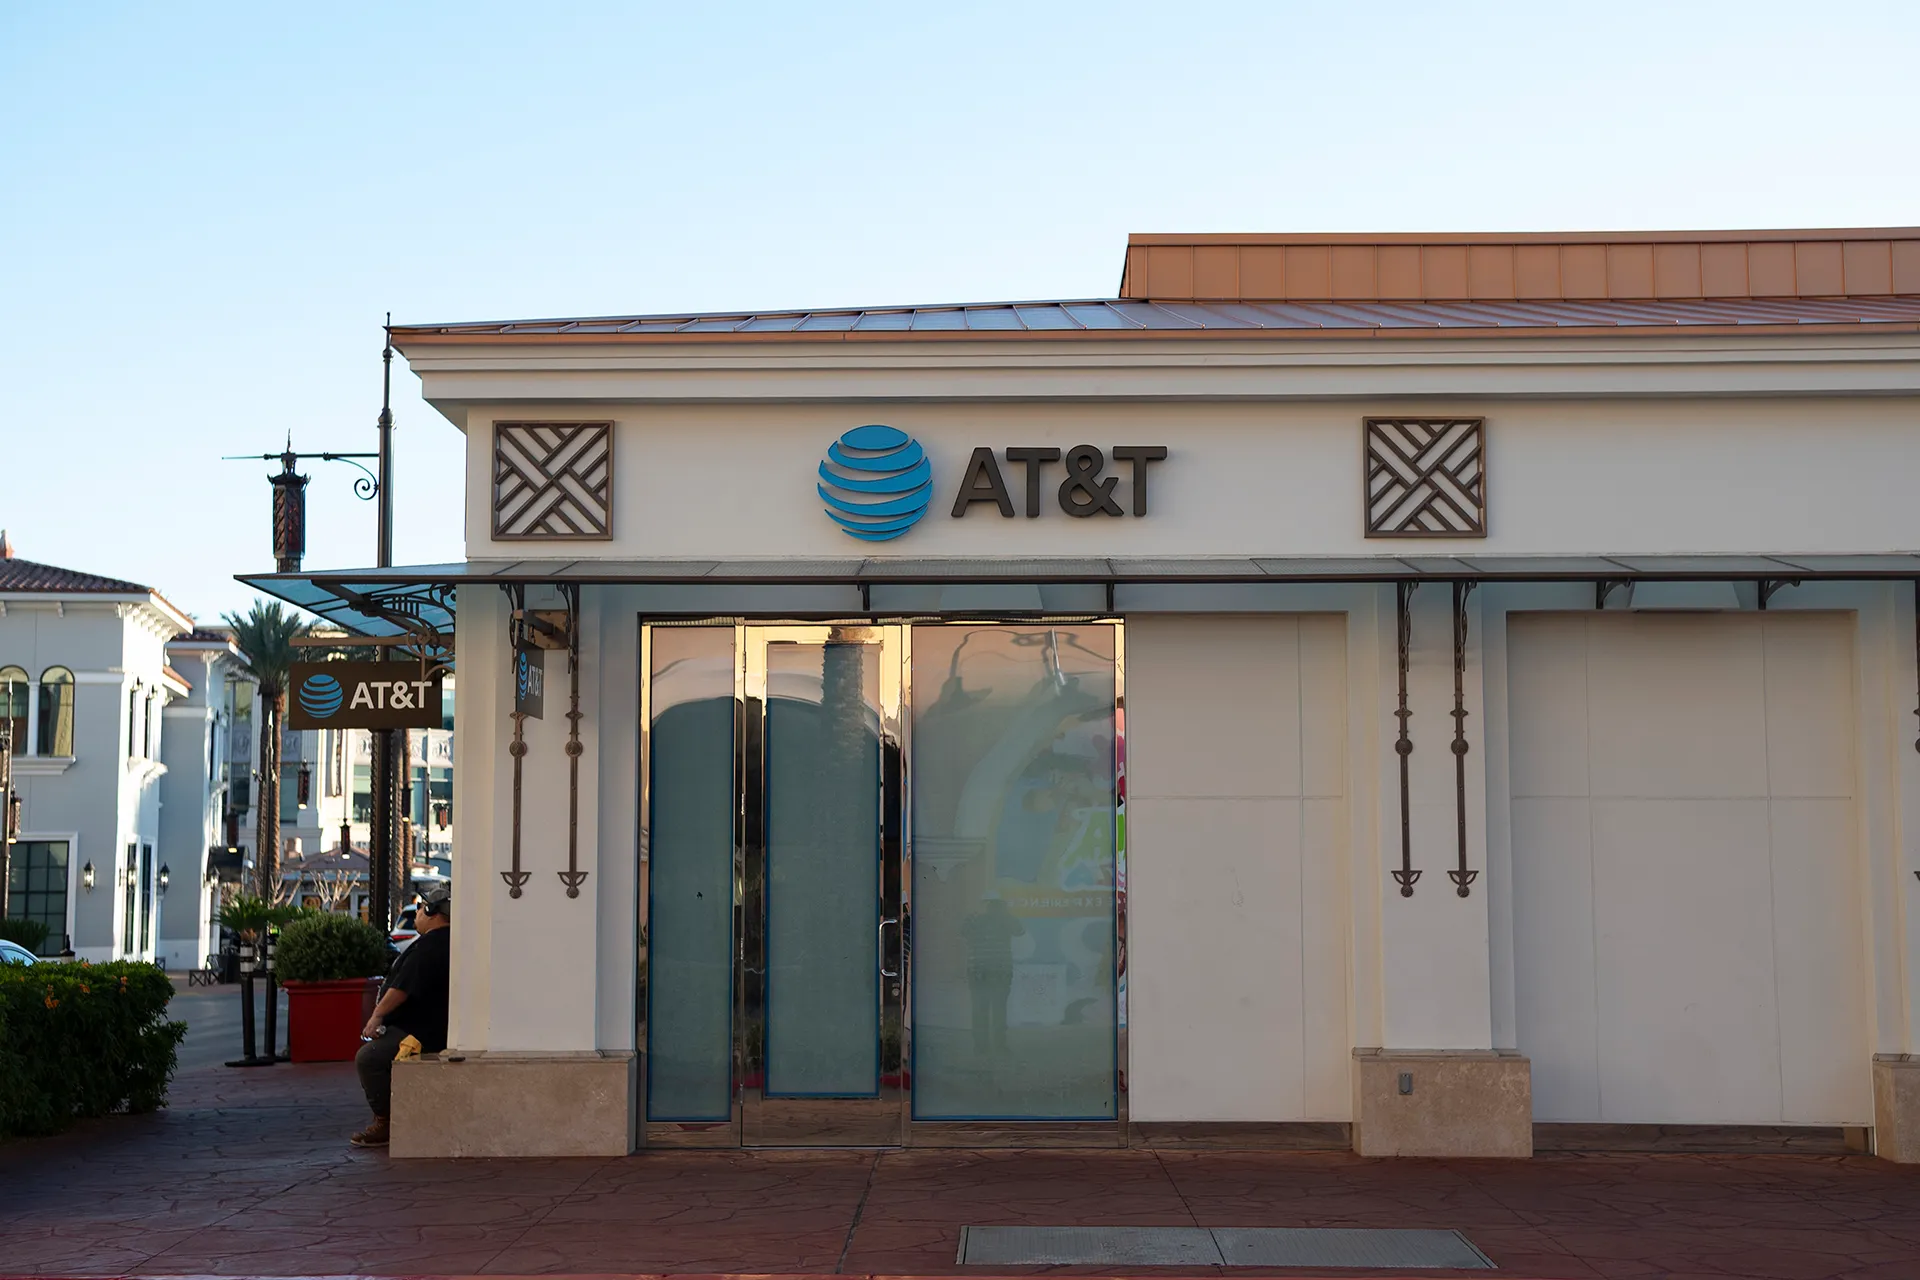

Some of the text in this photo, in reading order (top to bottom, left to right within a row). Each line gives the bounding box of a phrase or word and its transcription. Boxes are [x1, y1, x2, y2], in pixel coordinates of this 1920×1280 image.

[951, 444, 1168, 518] AT&T
[350, 680, 432, 710] AT&T
[527, 664, 543, 697] AT&T
